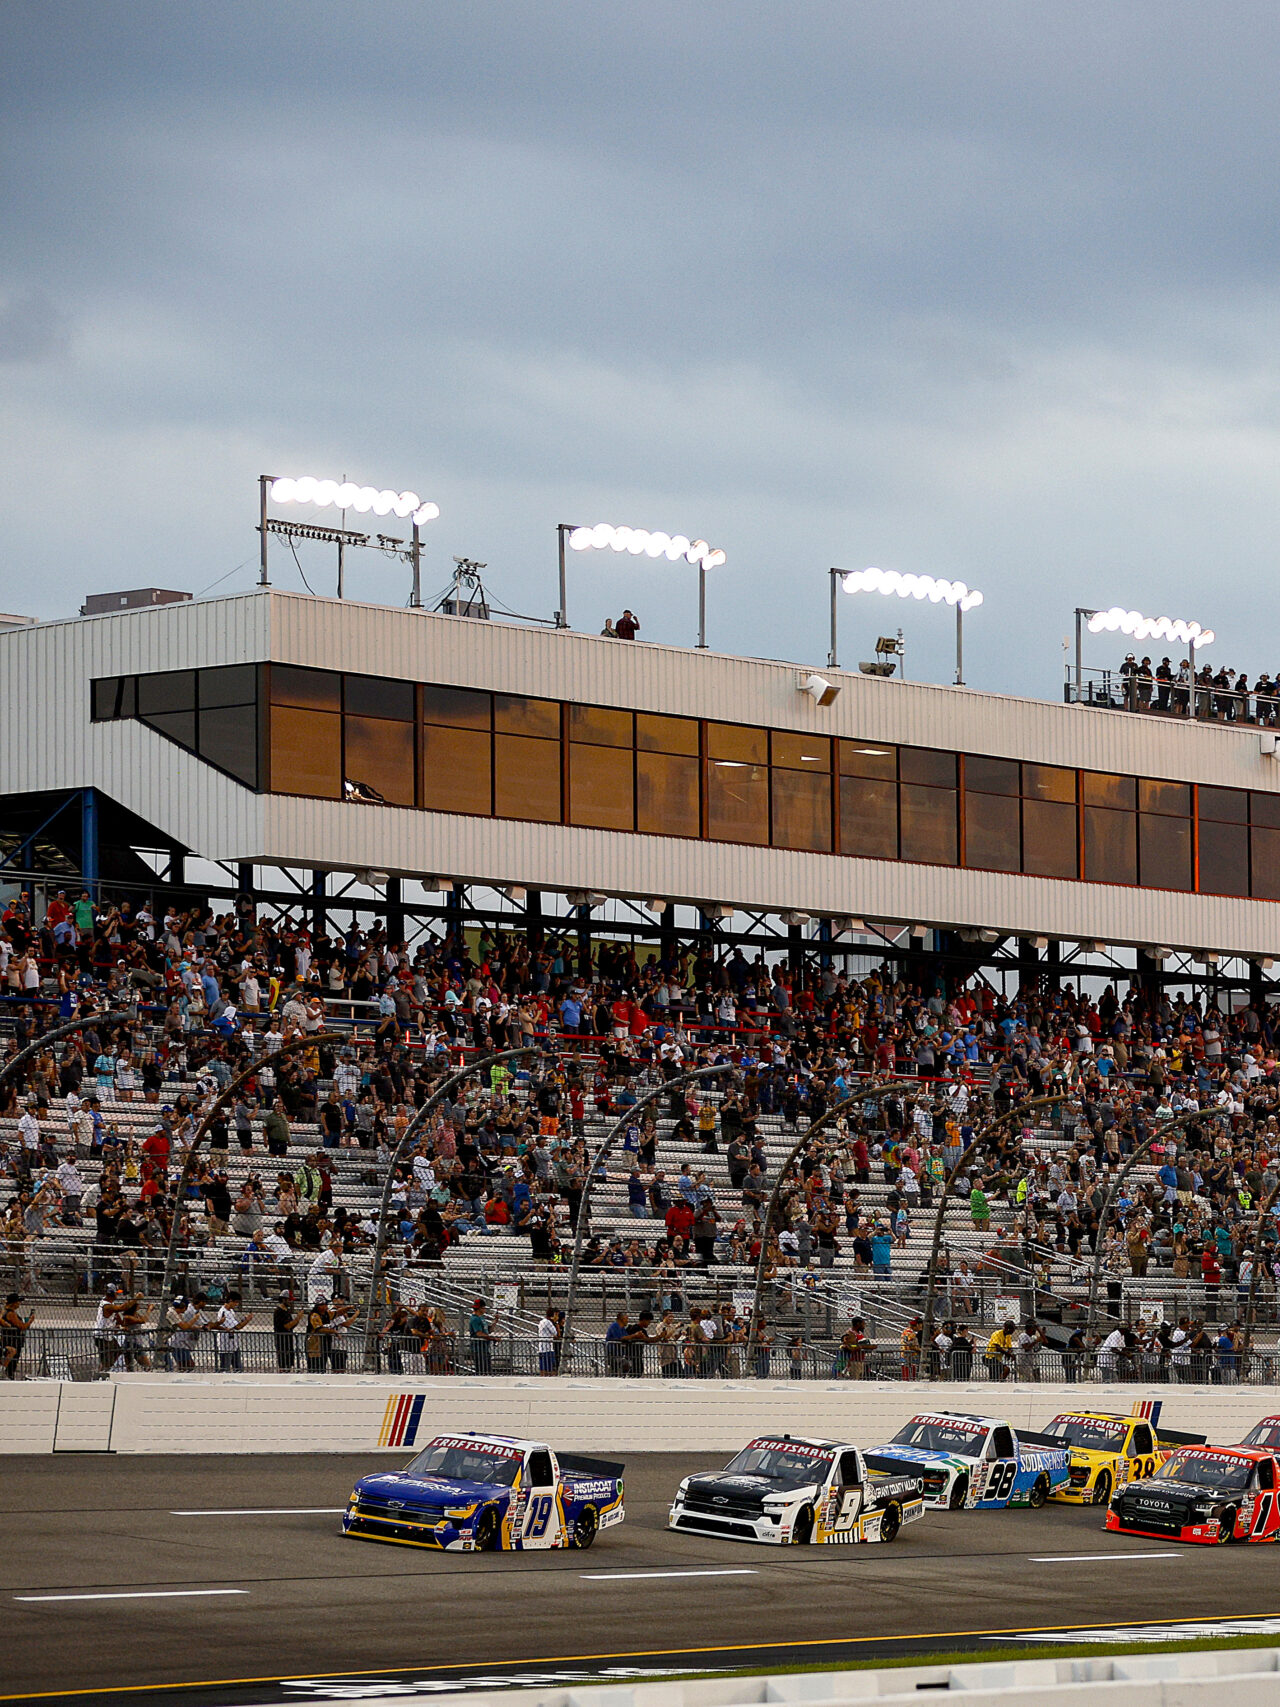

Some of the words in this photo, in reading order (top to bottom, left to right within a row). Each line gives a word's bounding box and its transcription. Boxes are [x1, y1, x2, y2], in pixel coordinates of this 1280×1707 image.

[914, 1416, 982, 1433] CRAFTSMAN
[1057, 1415, 1122, 1431] CRAFTSMAN
[433, 1437, 515, 1458] CRAFTSMAN
[753, 1439, 829, 1459] CRAFTSMAN
[1020, 1453, 1044, 1472] SODA
[1176, 1449, 1248, 1467] CRAFTSMAN
[1132, 1457, 1155, 1481] 38
[573, 1481, 613, 1494] INSTACOAT
[982, 1461, 1018, 1501] 98
[876, 1485, 890, 1499] GRANT
[835, 1490, 861, 1532] 9
[1139, 1499, 1170, 1509] TOYOTA
[523, 1493, 553, 1540] 19
[1251, 1492, 1274, 1536] 1
